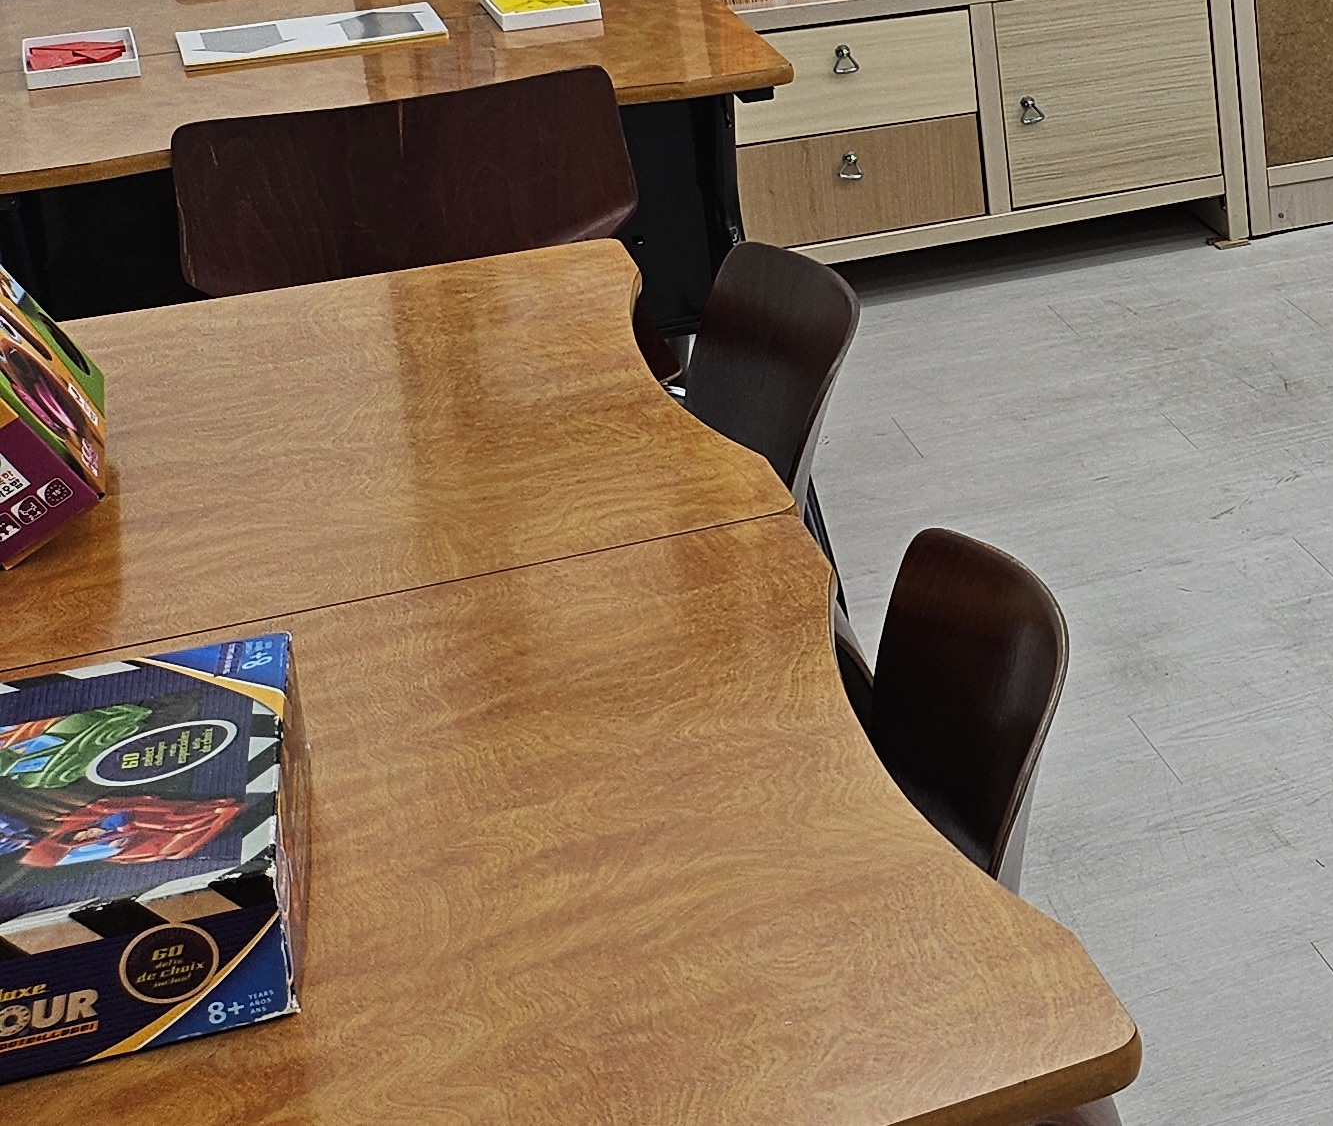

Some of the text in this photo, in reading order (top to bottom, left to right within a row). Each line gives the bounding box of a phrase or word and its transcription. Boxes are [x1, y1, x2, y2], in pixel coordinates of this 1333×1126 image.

[121, 752, 140, 769] 60
[151, 943, 185, 962] 60
[136, 960, 207, 985] de choix
[248, 989, 275, 1000] YEARS
[207, 999, 245, 1025] 8+
